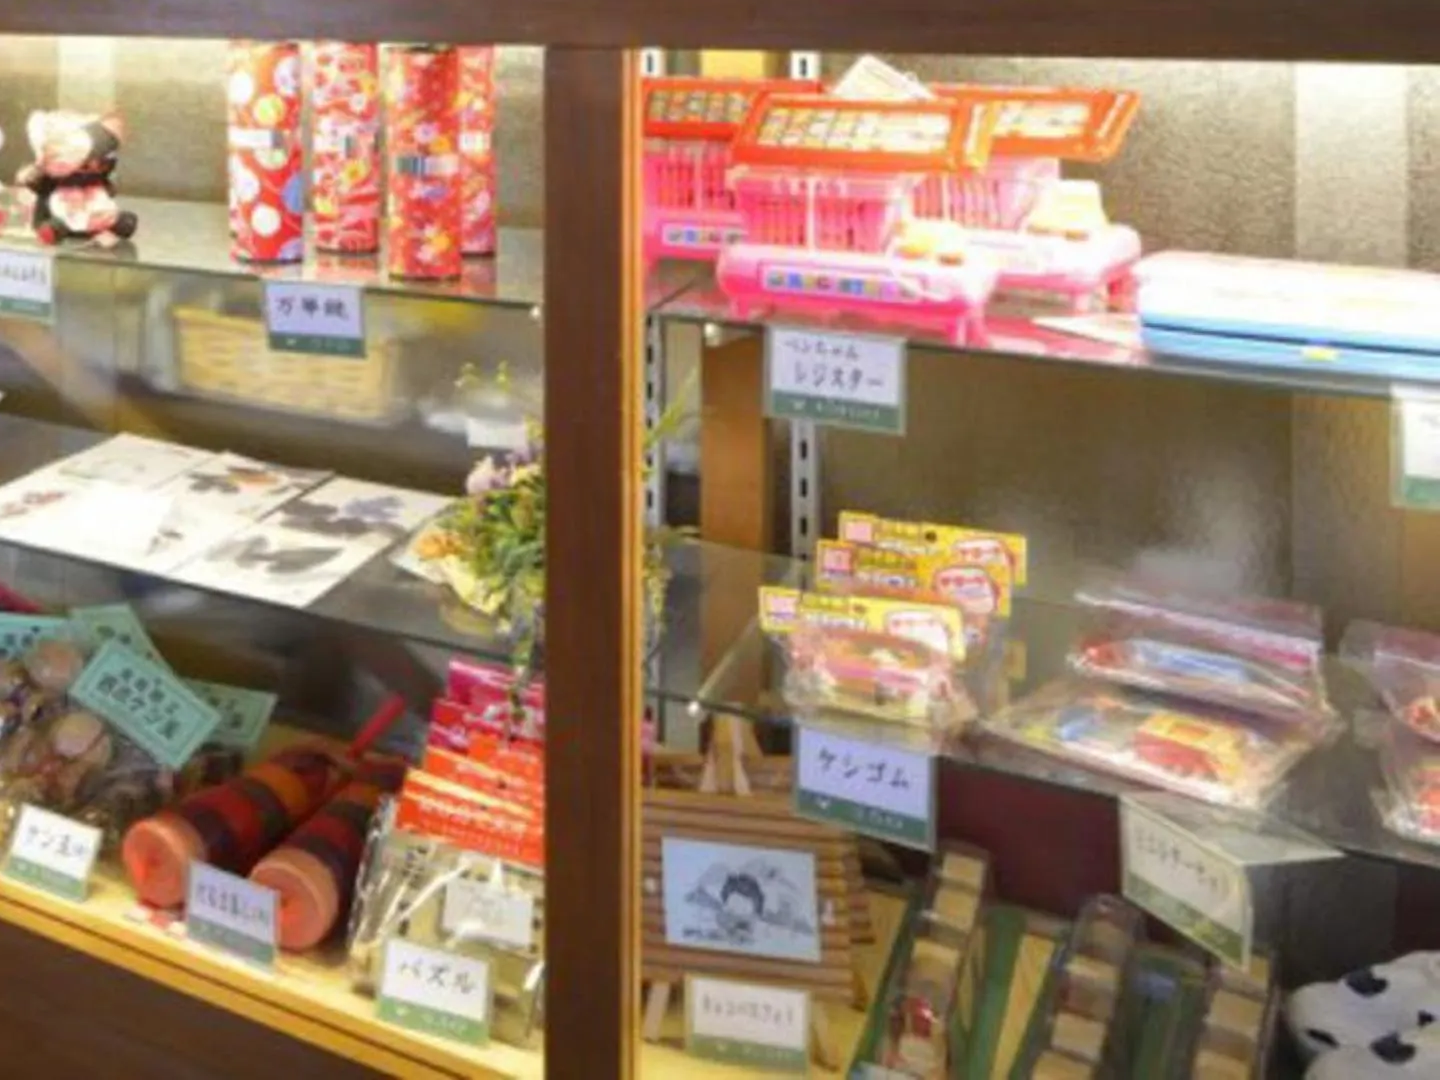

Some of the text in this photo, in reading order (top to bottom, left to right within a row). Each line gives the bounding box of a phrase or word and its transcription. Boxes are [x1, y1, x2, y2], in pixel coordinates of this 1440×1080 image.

[793, 360, 885, 391] レジスター
[813, 744, 912, 794] ケシゴム
[399, 956, 477, 998] パズル
